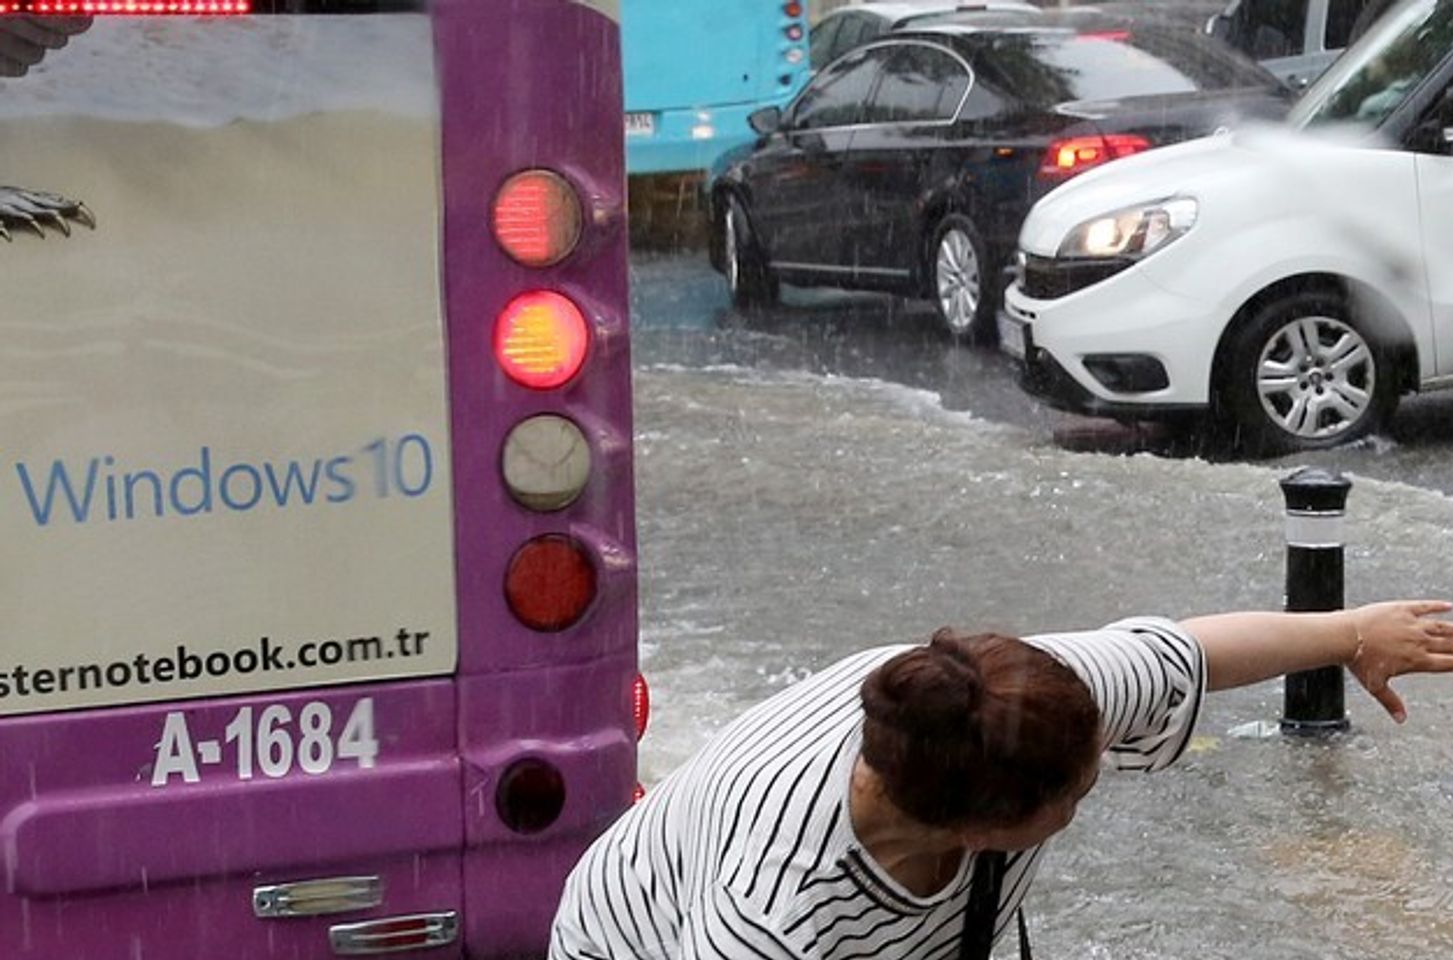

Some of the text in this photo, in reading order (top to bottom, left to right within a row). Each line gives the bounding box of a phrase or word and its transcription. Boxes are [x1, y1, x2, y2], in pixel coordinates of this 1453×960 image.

[16, 434, 433, 526] Windows 10
[151, 698, 379, 786] A-1684
